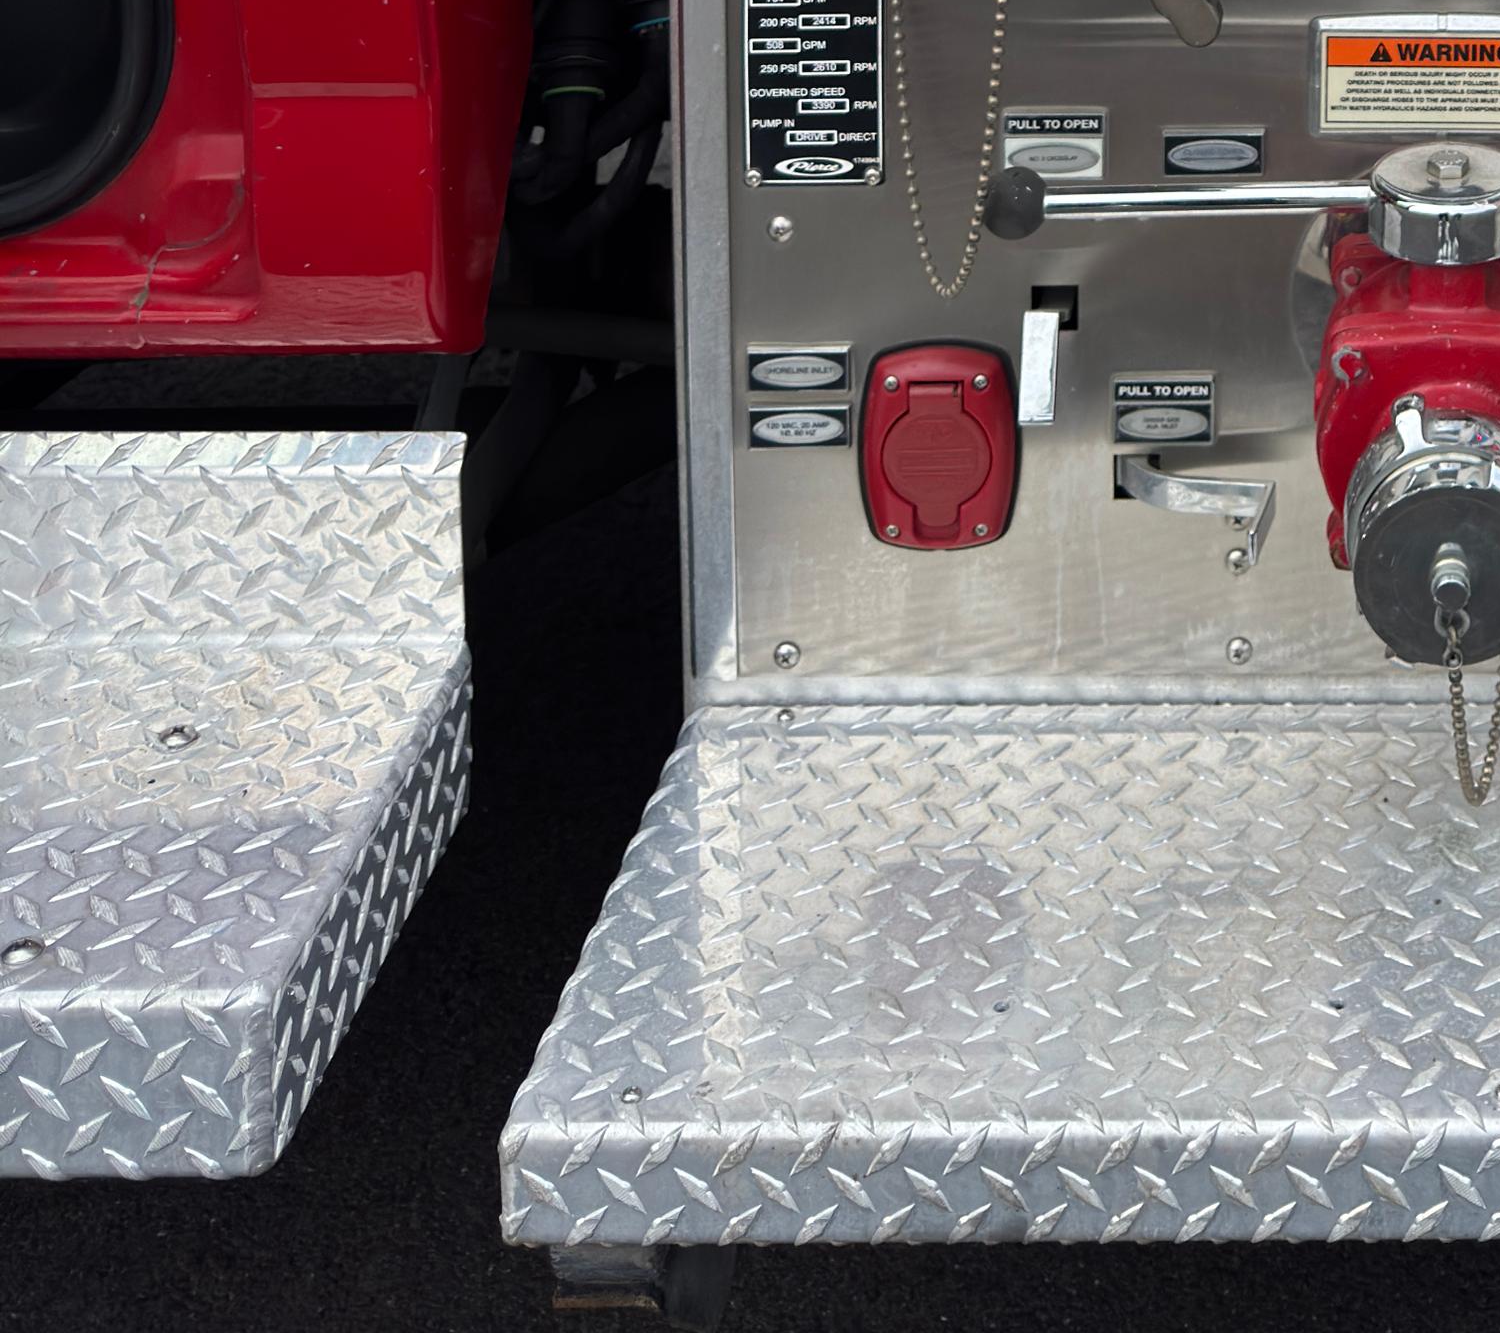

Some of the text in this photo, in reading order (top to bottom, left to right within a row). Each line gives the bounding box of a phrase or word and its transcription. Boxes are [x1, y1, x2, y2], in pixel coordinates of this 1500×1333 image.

[760, 17, 877, 27] 200 PSI 2414 RPM
[750, 87, 845, 97] GOVERNED SPEED
[812, 101, 877, 110] 3390 RPM
[752, 119, 794, 127] PUMP IN
[1008, 119, 1098, 129] PULL TO OPEN
[796, 133, 876, 141] DRIVE DIRECT
[793, 161, 839, 172] Pierce
[1119, 386, 1208, 396] PULL TO OPEN
